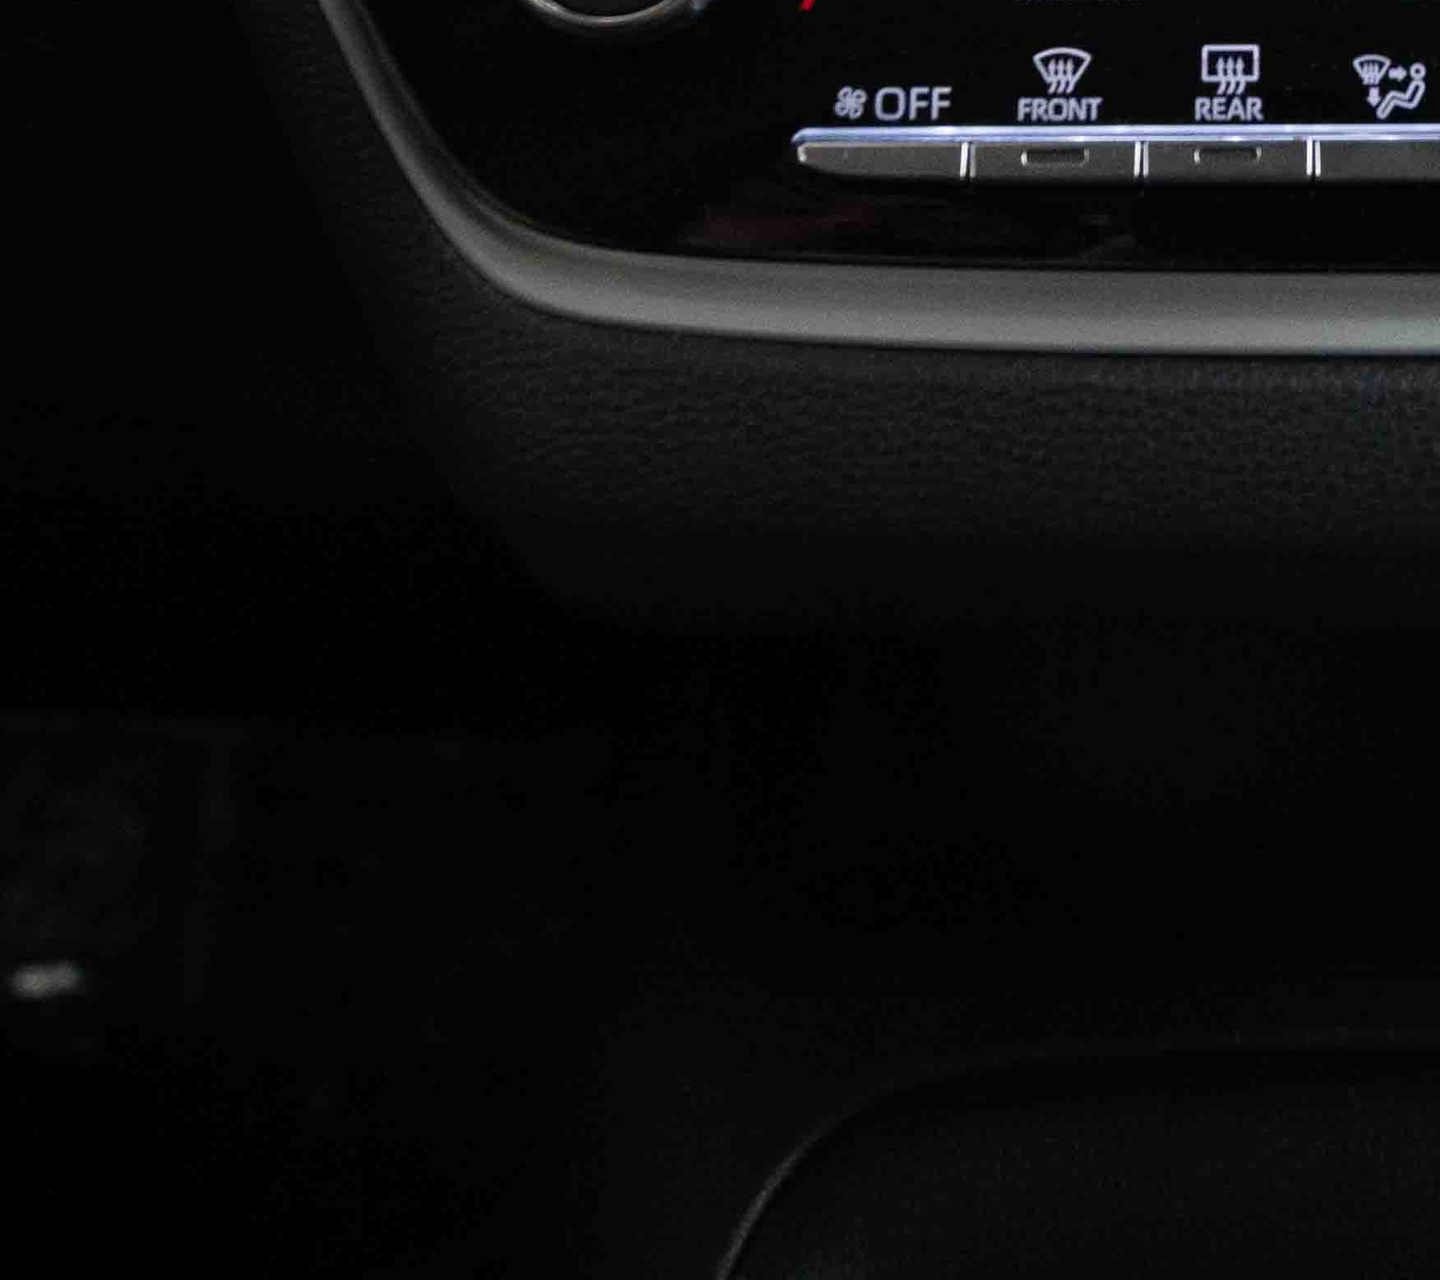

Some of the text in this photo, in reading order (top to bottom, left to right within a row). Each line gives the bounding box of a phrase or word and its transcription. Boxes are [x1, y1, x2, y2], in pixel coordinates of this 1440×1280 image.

[874, 86, 952, 121] OFF
[1016, 97, 1104, 122] FRONT
[1194, 97, 1264, 122] REAR
